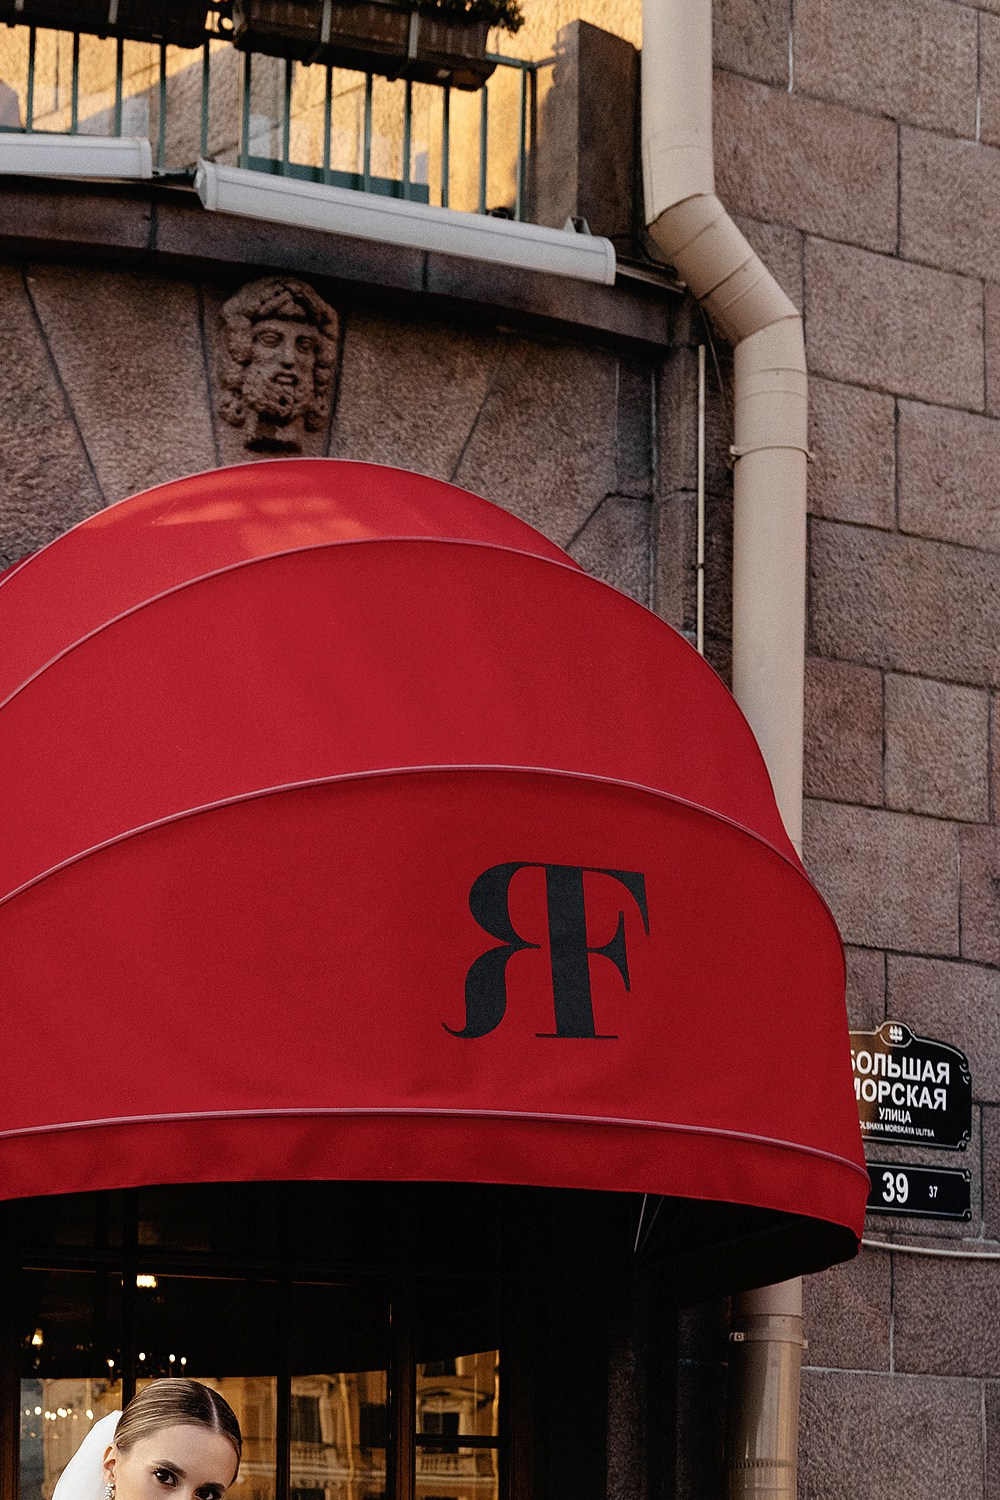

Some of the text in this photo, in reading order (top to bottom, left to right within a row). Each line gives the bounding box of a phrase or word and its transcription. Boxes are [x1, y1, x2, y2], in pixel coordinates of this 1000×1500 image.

[879, 1107, 912, 1124] УЛИЦА
[859, 1120, 935, 1137] OLSHAYA MORSKAYA ULITSA
[882, 1171, 938, 1203] 39 37
